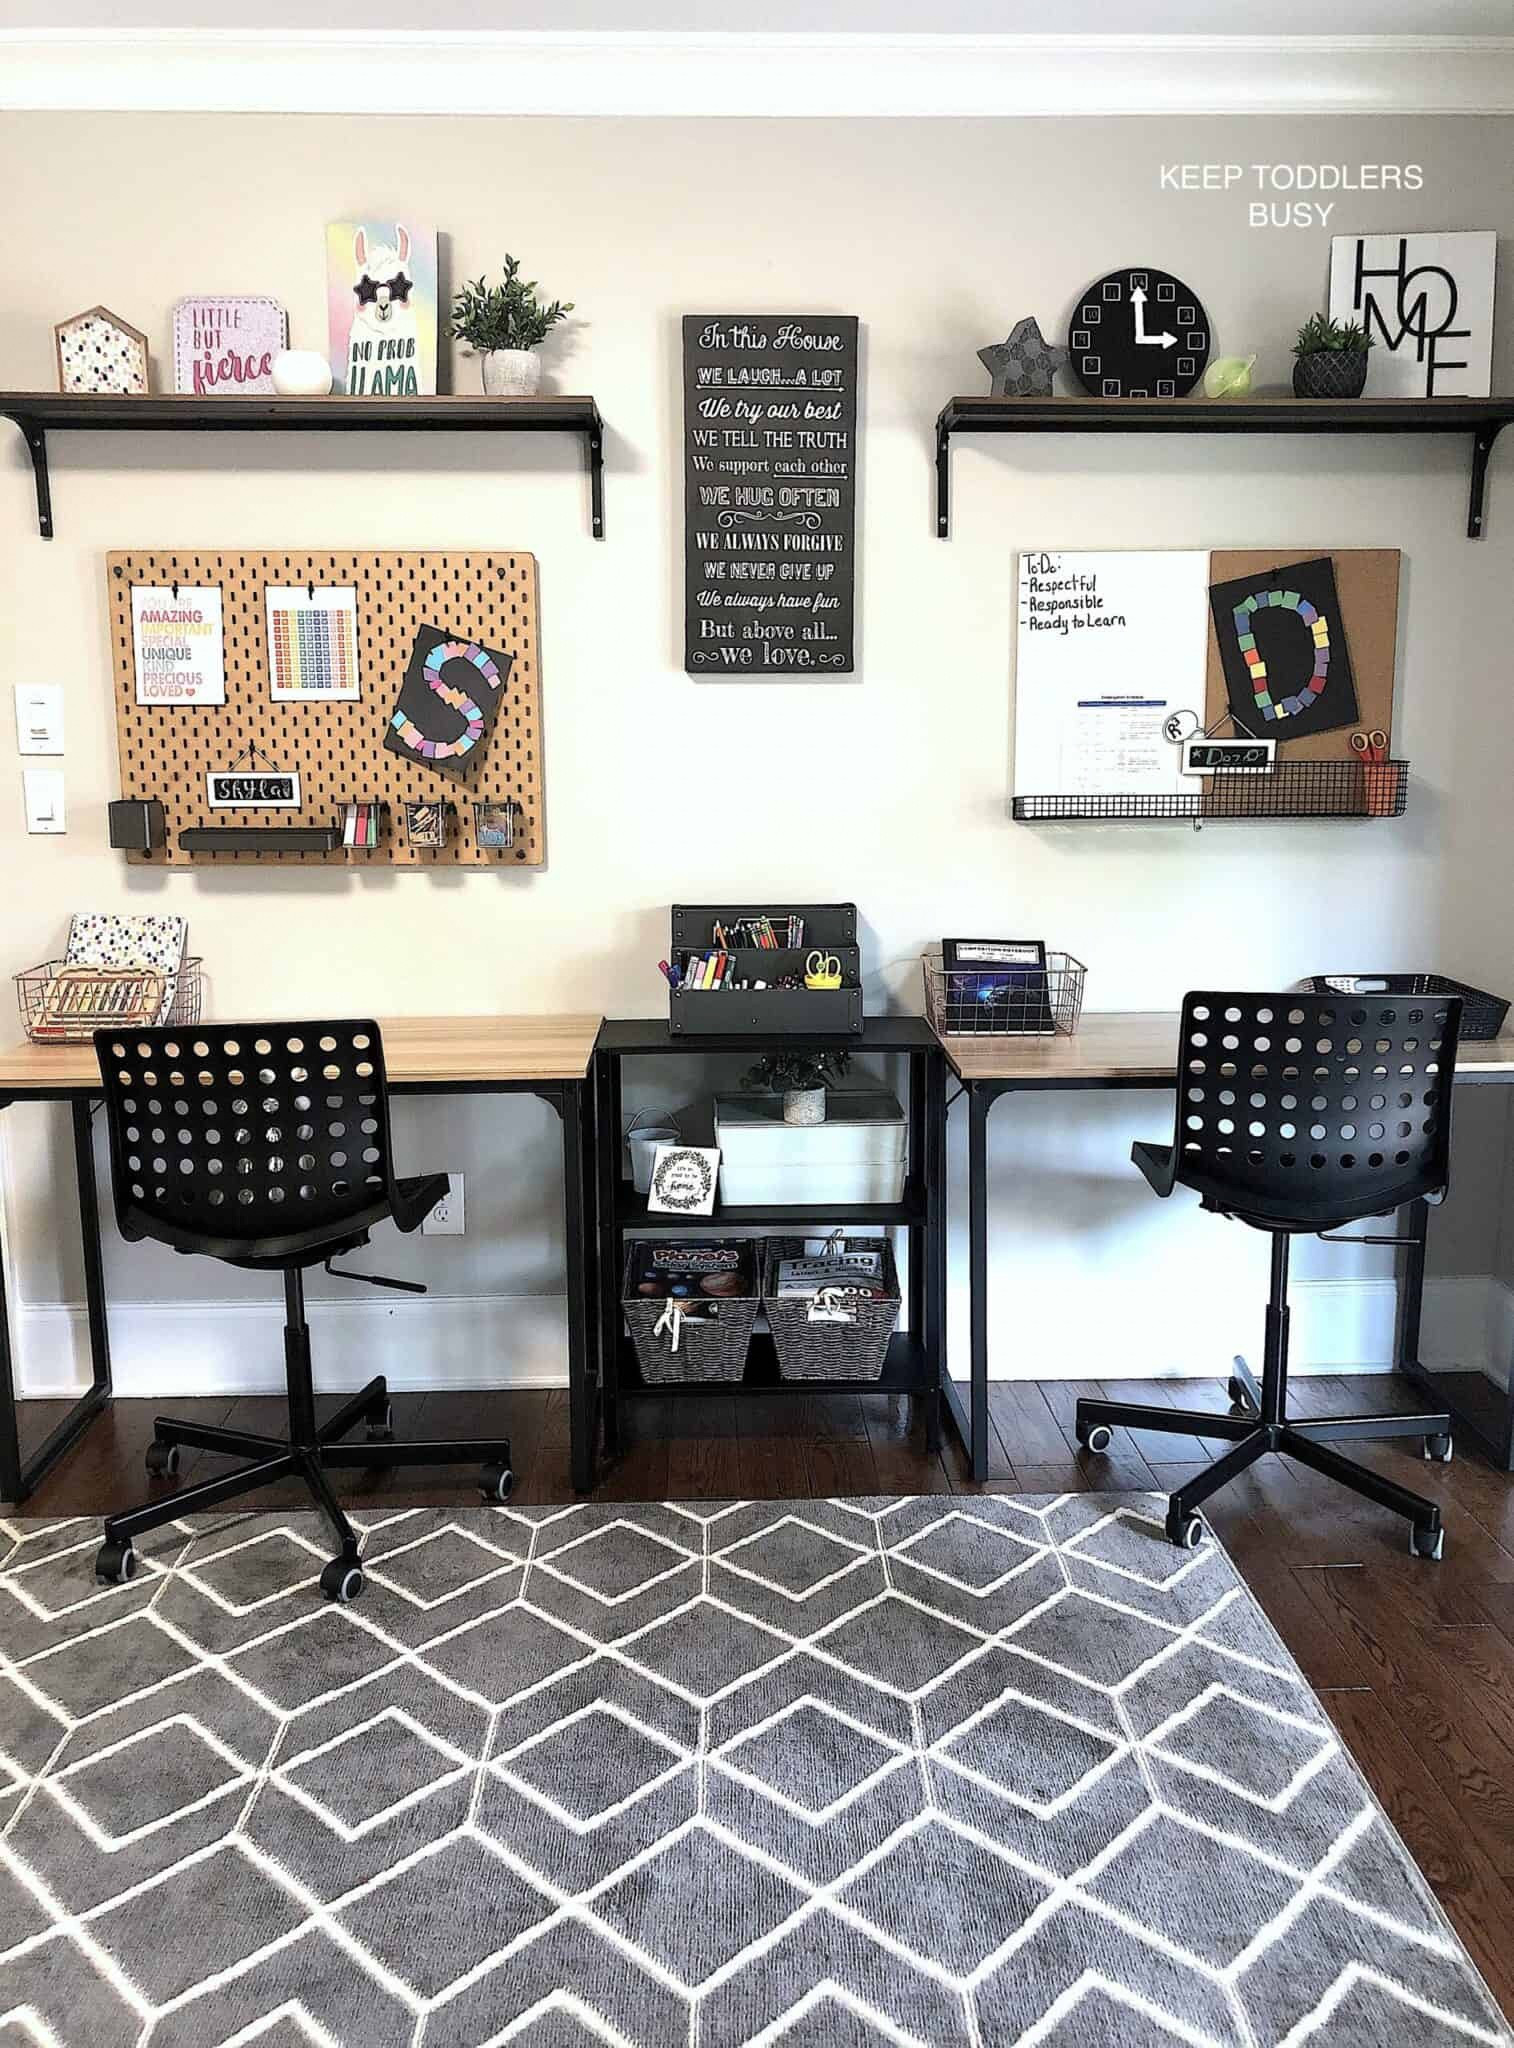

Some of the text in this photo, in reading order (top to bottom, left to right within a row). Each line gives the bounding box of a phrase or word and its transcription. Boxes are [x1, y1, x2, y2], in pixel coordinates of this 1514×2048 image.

[192, 308, 242, 329] LITTLE
[193, 329, 223, 349] BUT
[699, 322, 844, 350] In this House
[352, 337, 415, 362] NO PROB
[192, 350, 272, 395] fierce
[698, 367, 722, 384] WE
[811, 369, 843, 386] LOT
[699, 398, 842, 424] We try our best
[692, 430, 848, 449] WE TELL THE TRUTH
[692, 455, 848, 476] We support each other
[699, 486, 840, 507] WE HUG OFTEN
[696, 533, 844, 552] WE ALWAYS FORGIVE
[703, 562, 834, 580] WE NEVER GIVE UP
[696, 590, 841, 613] We always have fun
[140, 609, 203, 623] AMAZING
[1072, 615, 1085, 629] to
[1086, 613, 1127, 628] Learn
[142, 623, 214, 635] IMPORTANT
[700, 619, 735, 639] But
[742, 620, 794, 640] above
[142, 635, 189, 647] SPECIAL
[142, 647, 192, 660] UNIQUE
[720, 642, 816, 666] we love.
[1232, 590, 1330, 721] D
[142, 660, 175, 672] KIND
[143, 672, 203, 685] PRECIOUS
[143, 685, 183, 697] LOVED
[391, 641, 500, 759] S
